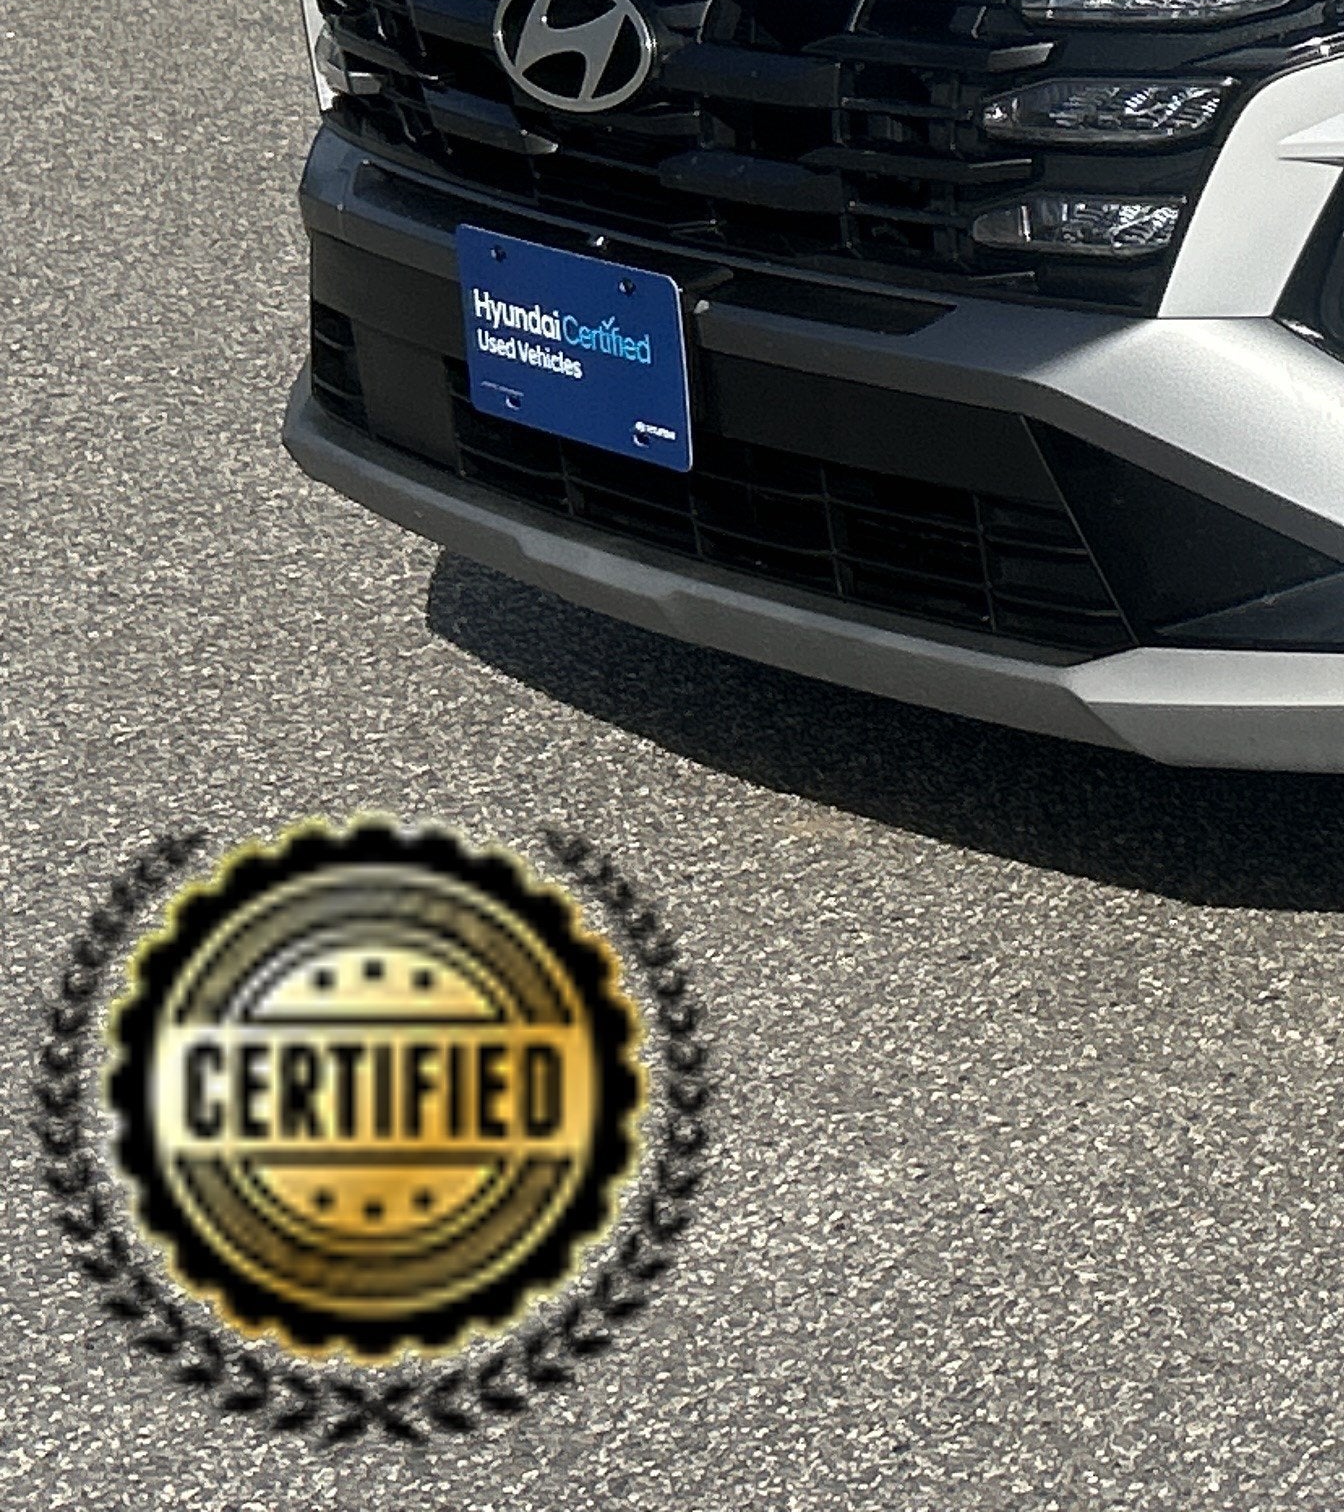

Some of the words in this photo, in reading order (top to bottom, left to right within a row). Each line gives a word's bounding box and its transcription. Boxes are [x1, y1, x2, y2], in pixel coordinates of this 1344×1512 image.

[472, 288, 562, 341] Hyundai
[562, 315, 652, 364] Certified
[476, 328, 516, 360] Used
[517, 340, 583, 379] Vehicles
